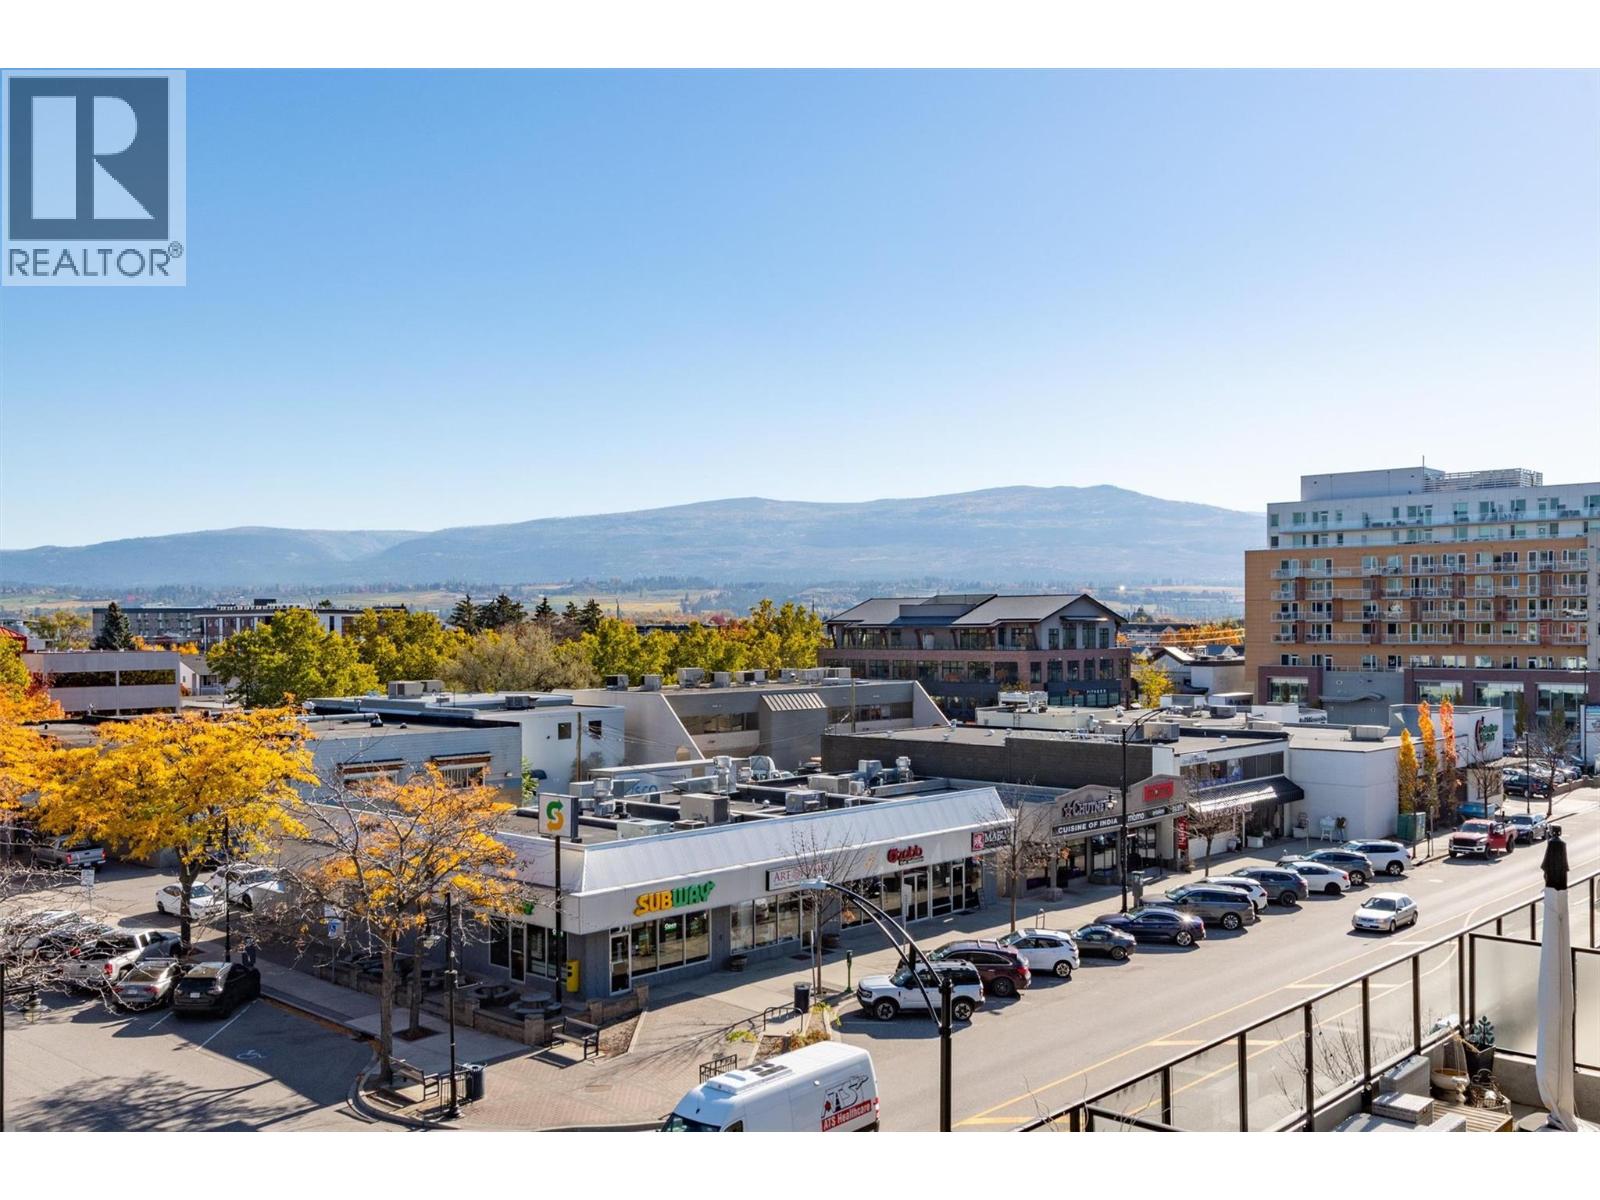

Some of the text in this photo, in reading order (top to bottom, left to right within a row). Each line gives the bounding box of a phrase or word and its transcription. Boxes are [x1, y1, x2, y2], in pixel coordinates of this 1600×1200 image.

[1058, 818, 1118, 834] CUISINE OF INDIA
[774, 870, 791, 882] ART
[633, 880, 716, 917] SUBWAY
[823, 1103, 871, 1131] ATS Healthcare
